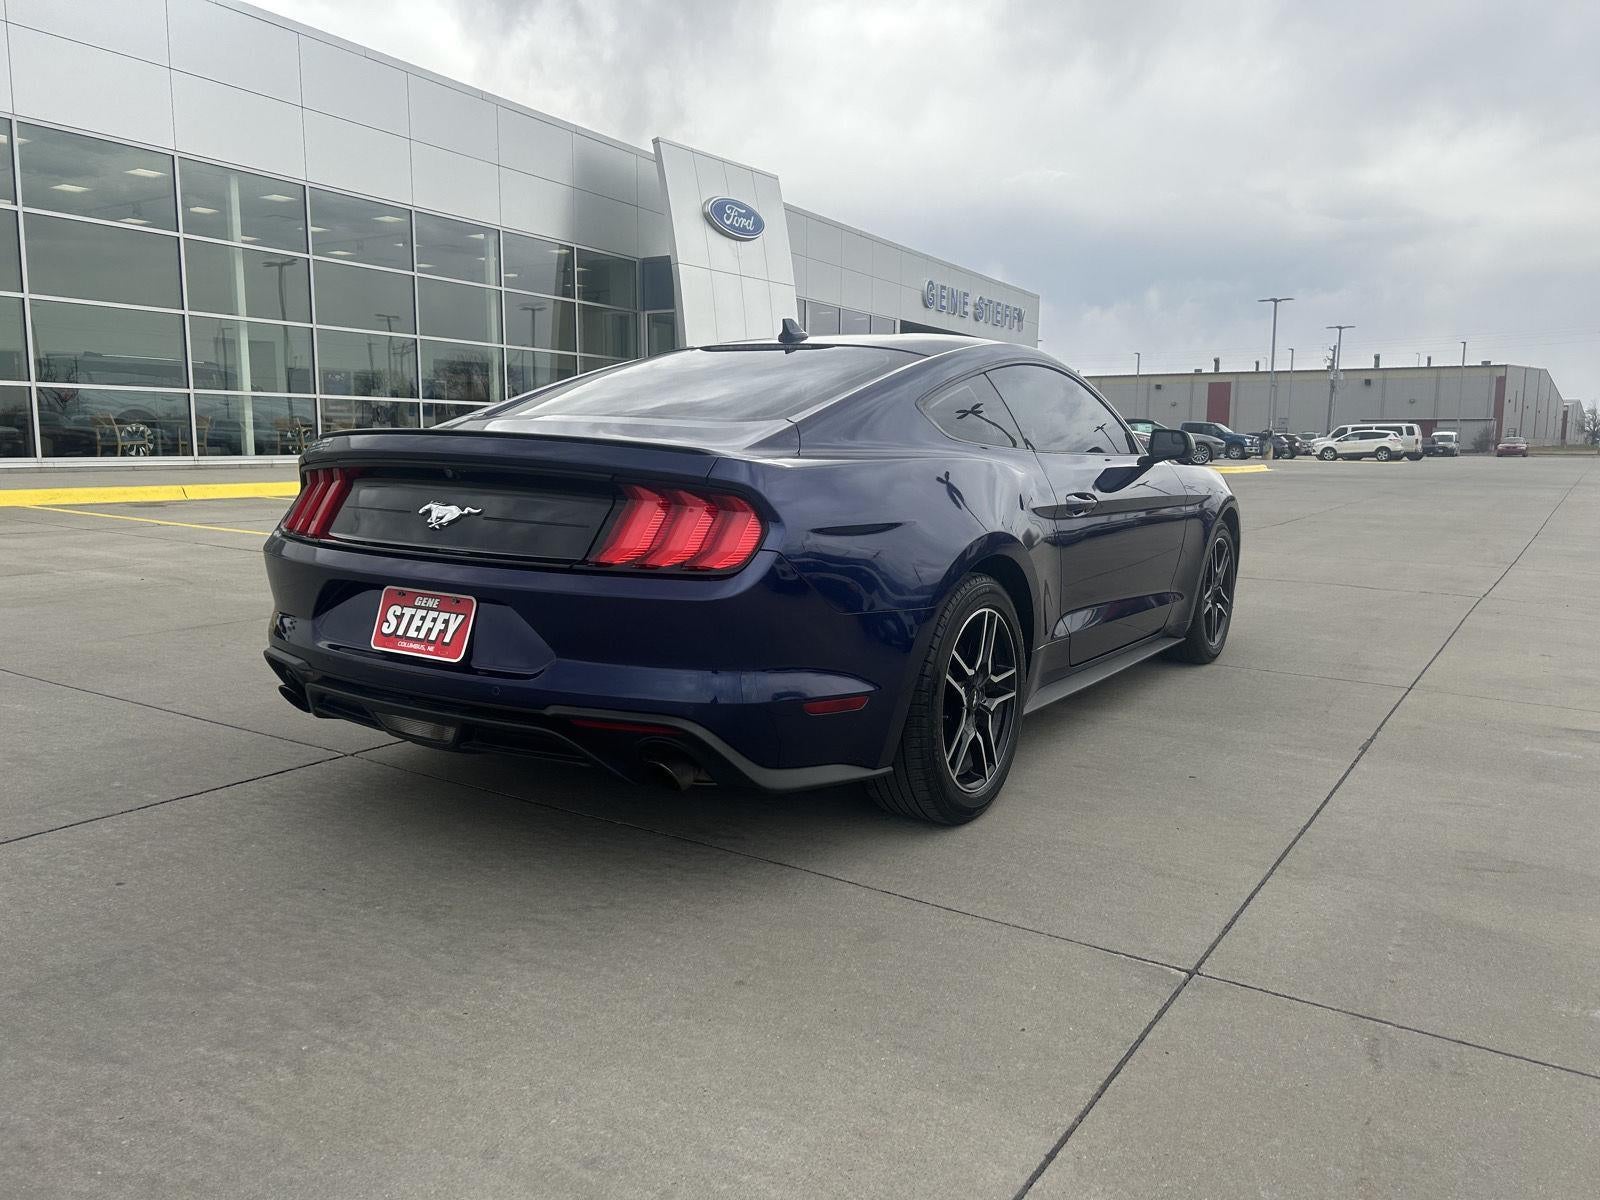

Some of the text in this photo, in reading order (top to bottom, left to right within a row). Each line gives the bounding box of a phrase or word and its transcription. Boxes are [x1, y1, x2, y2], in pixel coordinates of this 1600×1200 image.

[723, 204, 755, 231] Ford
[923, 279, 1026, 332] GENE STEFFY
[414, 596, 440, 608] GENE
[381, 605, 465, 643] STEFFY
[397, 641, 426, 651] COLUMBUS,
